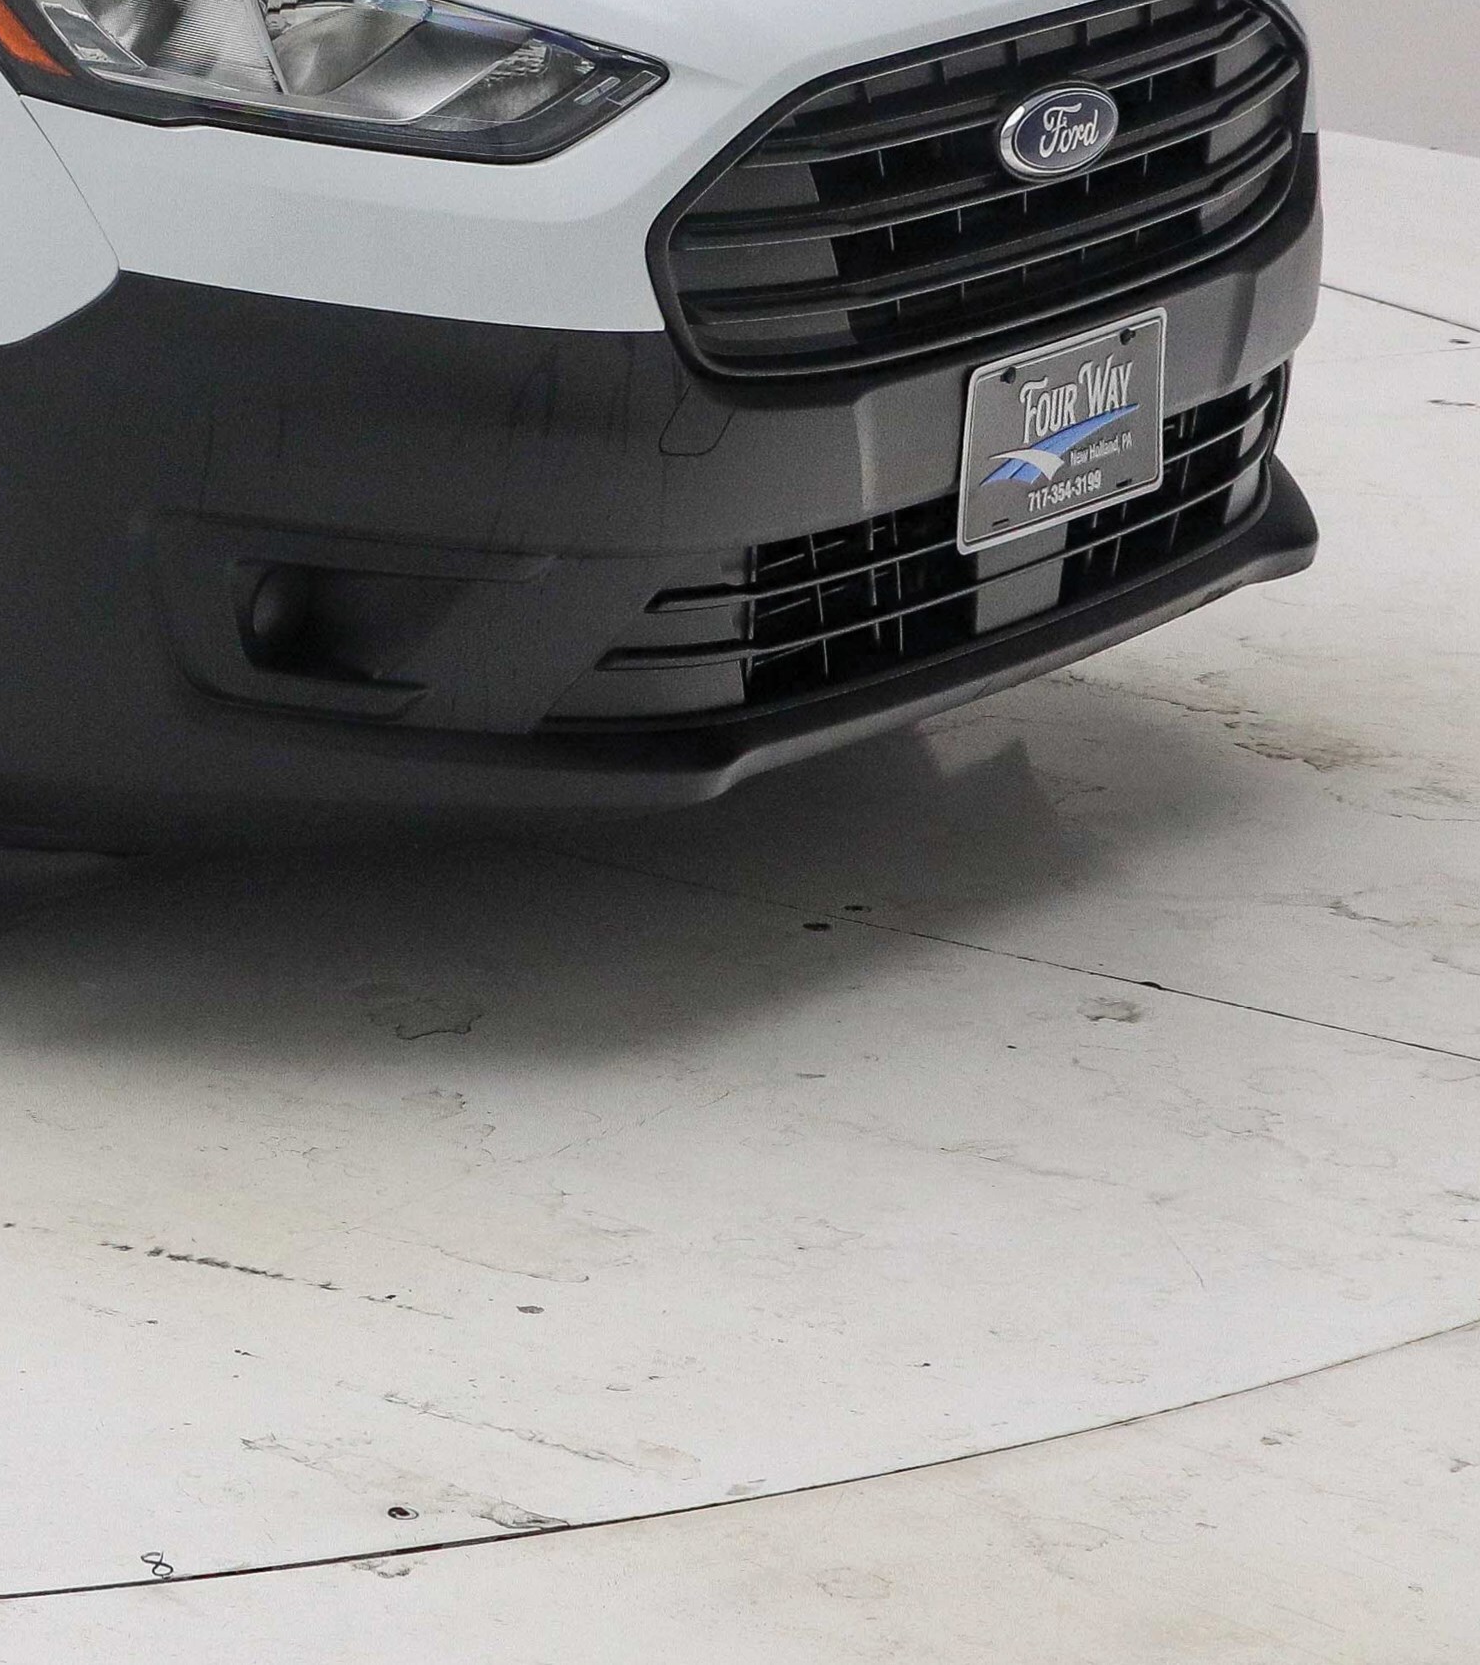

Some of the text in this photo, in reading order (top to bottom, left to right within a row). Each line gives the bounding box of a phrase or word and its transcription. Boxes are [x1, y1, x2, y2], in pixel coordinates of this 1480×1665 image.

[1039, 102, 1100, 159] Ford
[1122, 431, 1133, 451] PA
[1027, 468, 1102, 513] 717-354-3199
